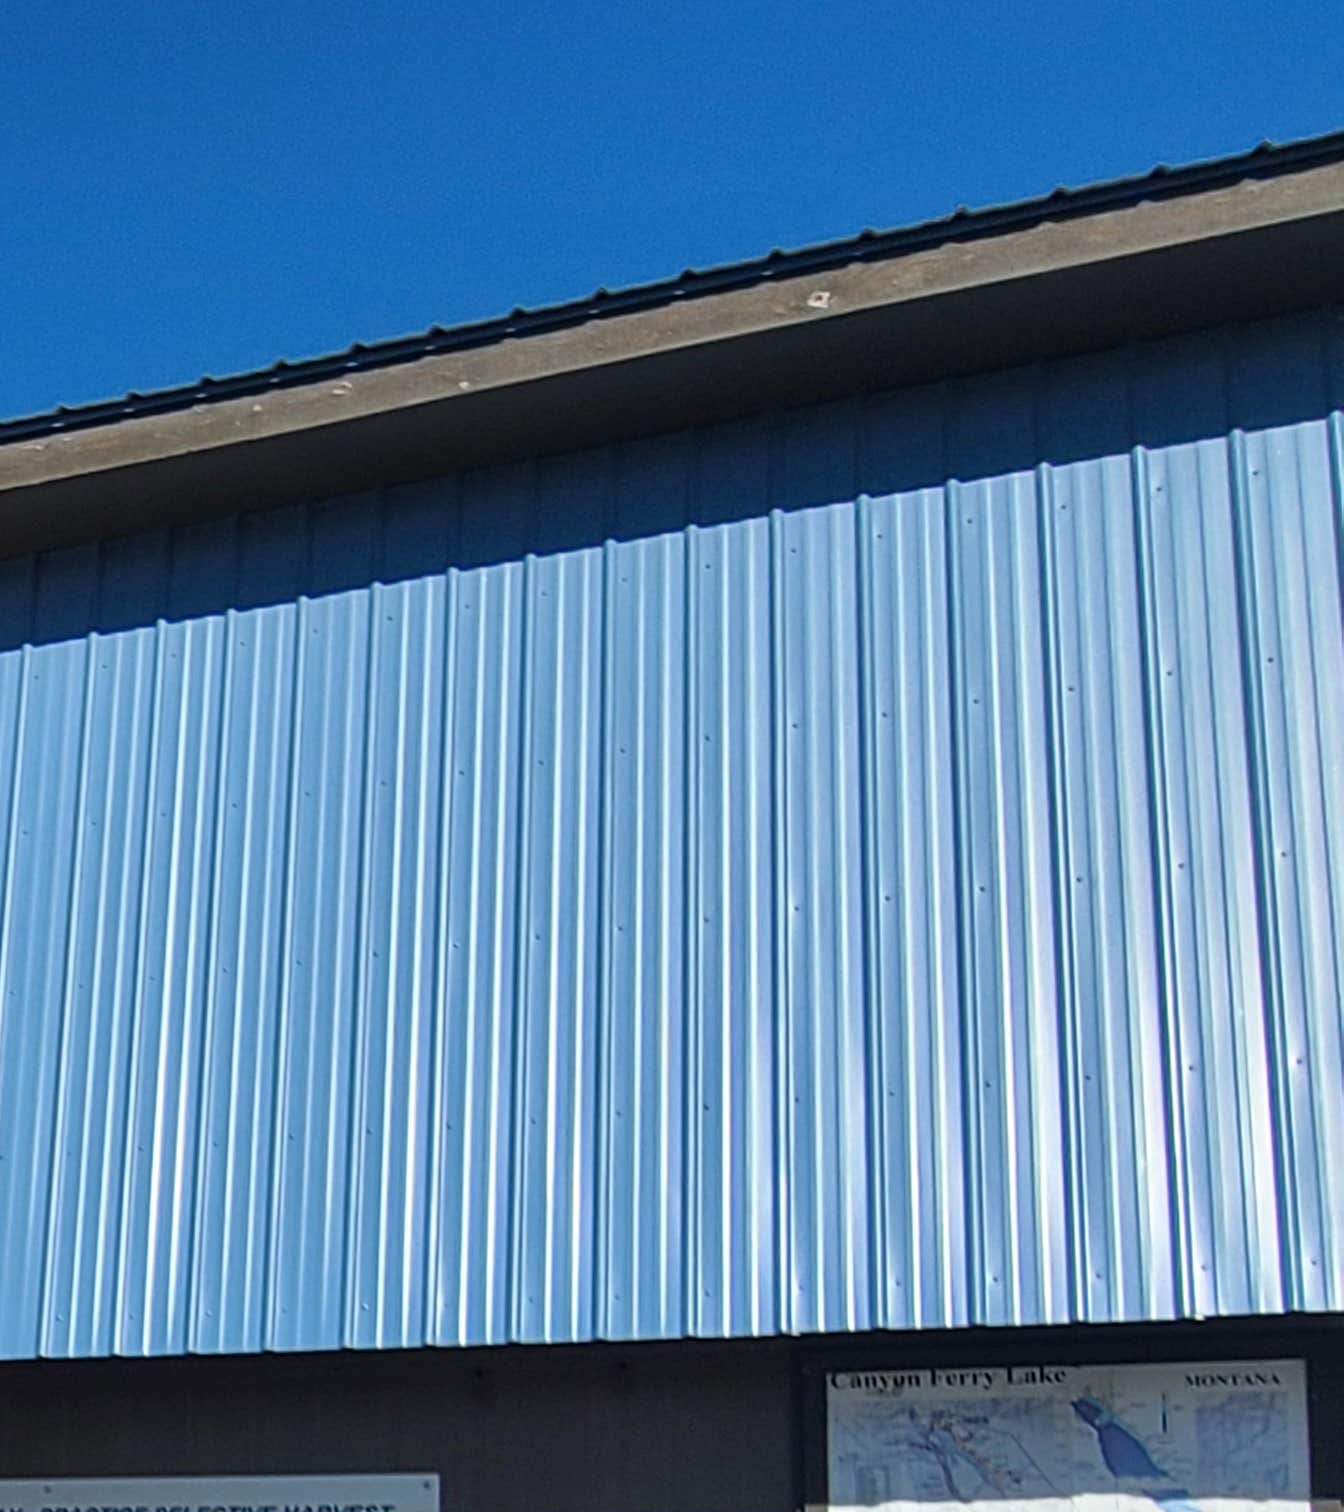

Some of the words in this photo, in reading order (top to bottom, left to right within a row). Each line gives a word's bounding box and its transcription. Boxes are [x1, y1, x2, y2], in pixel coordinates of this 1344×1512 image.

[830, 1373, 921, 1393] Canyon
[929, 1369, 995, 1390] Ferry
[1006, 1366, 1067, 1385] Lake
[1185, 1374, 1282, 1387] MONTANA
